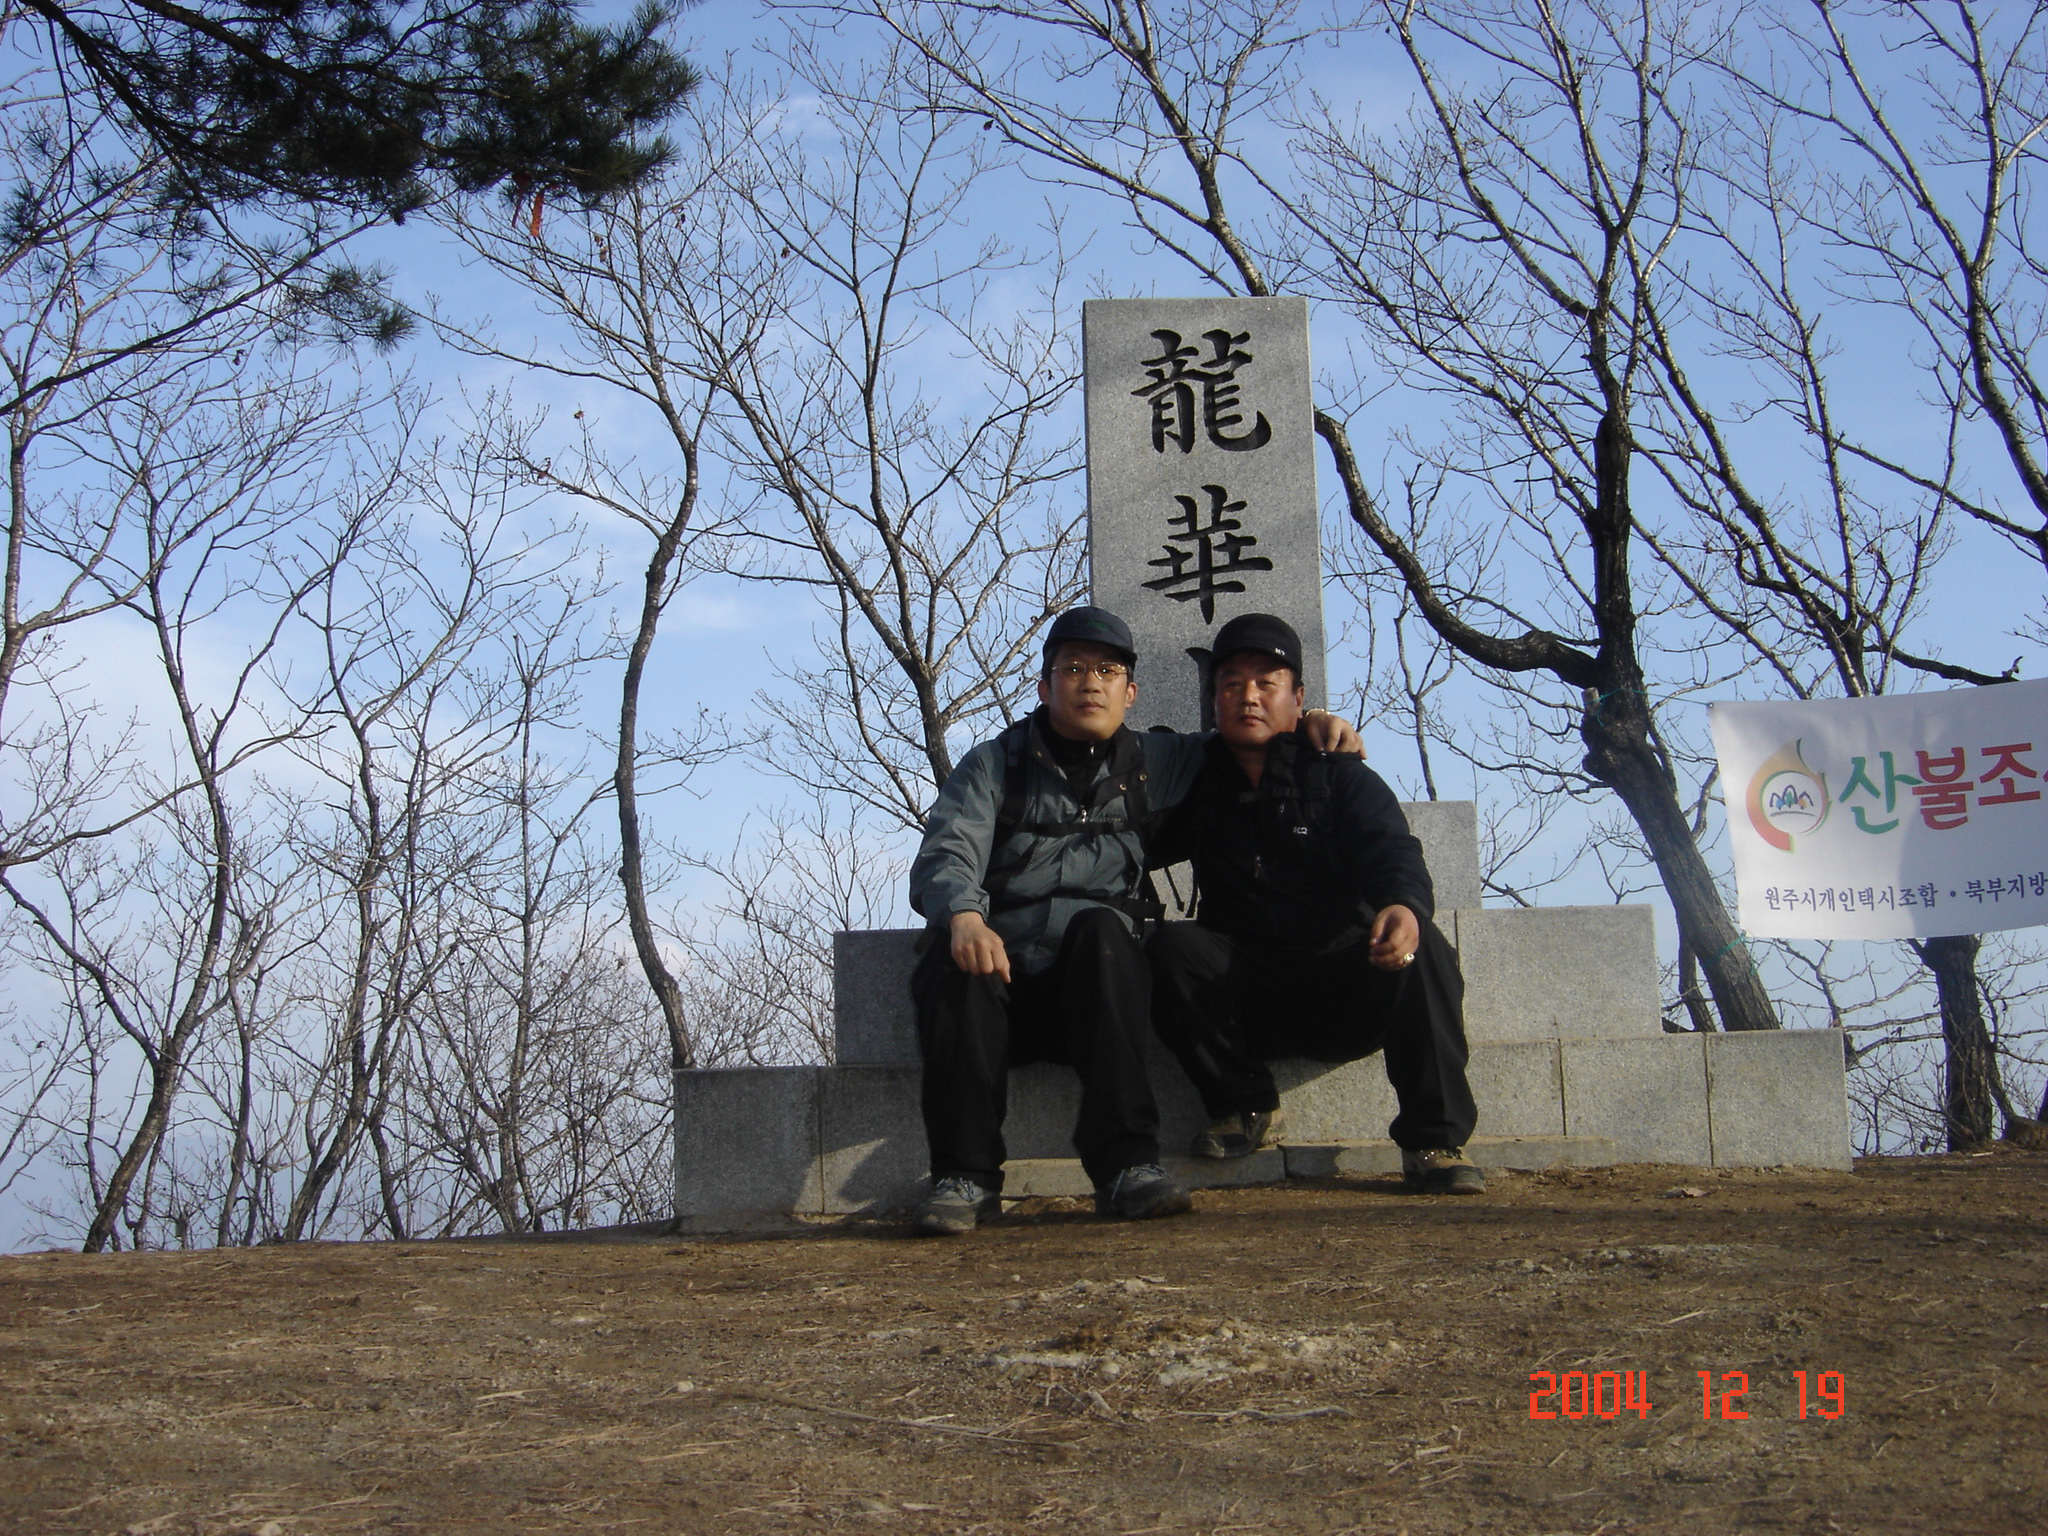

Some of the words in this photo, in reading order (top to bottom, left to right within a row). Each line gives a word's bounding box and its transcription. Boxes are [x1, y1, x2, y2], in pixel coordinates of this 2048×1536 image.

[1131, 328, 1273, 732] 龍華
[1838, 742, 2048, 836] 산불조
[1765, 882, 1938, 912] 원주시개인택시조합
